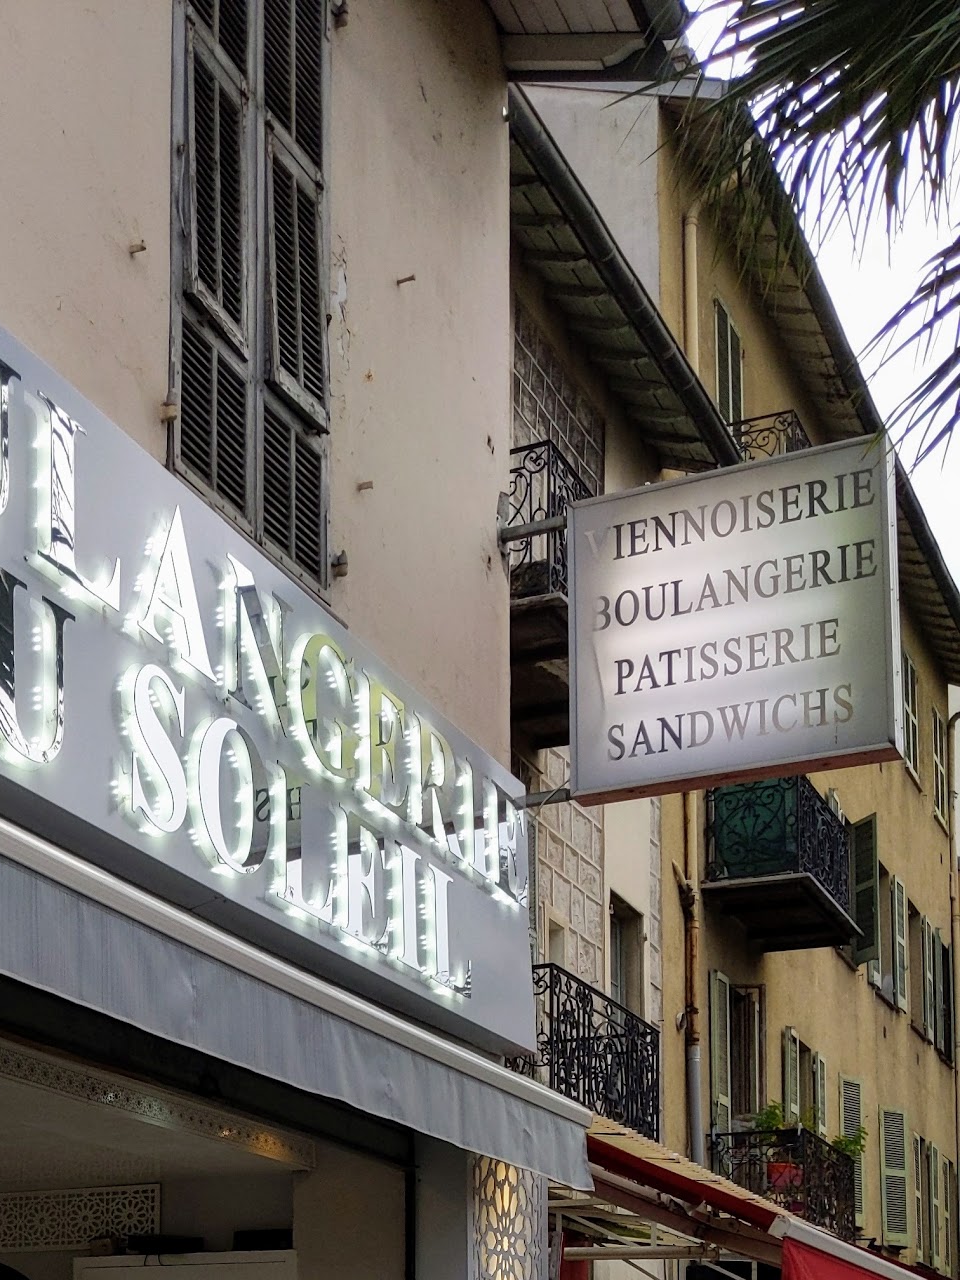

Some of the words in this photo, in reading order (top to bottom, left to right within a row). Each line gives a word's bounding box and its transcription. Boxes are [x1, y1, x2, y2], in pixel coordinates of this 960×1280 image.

[585, 467, 877, 561] VIENNOISERIE
[593, 538, 878, 632] BOULANGERIE
[614, 618, 842, 696] PATISSERIE
[607, 682, 854, 761] SANDWICHS
[126, 663, 473, 999] SOLEIL
